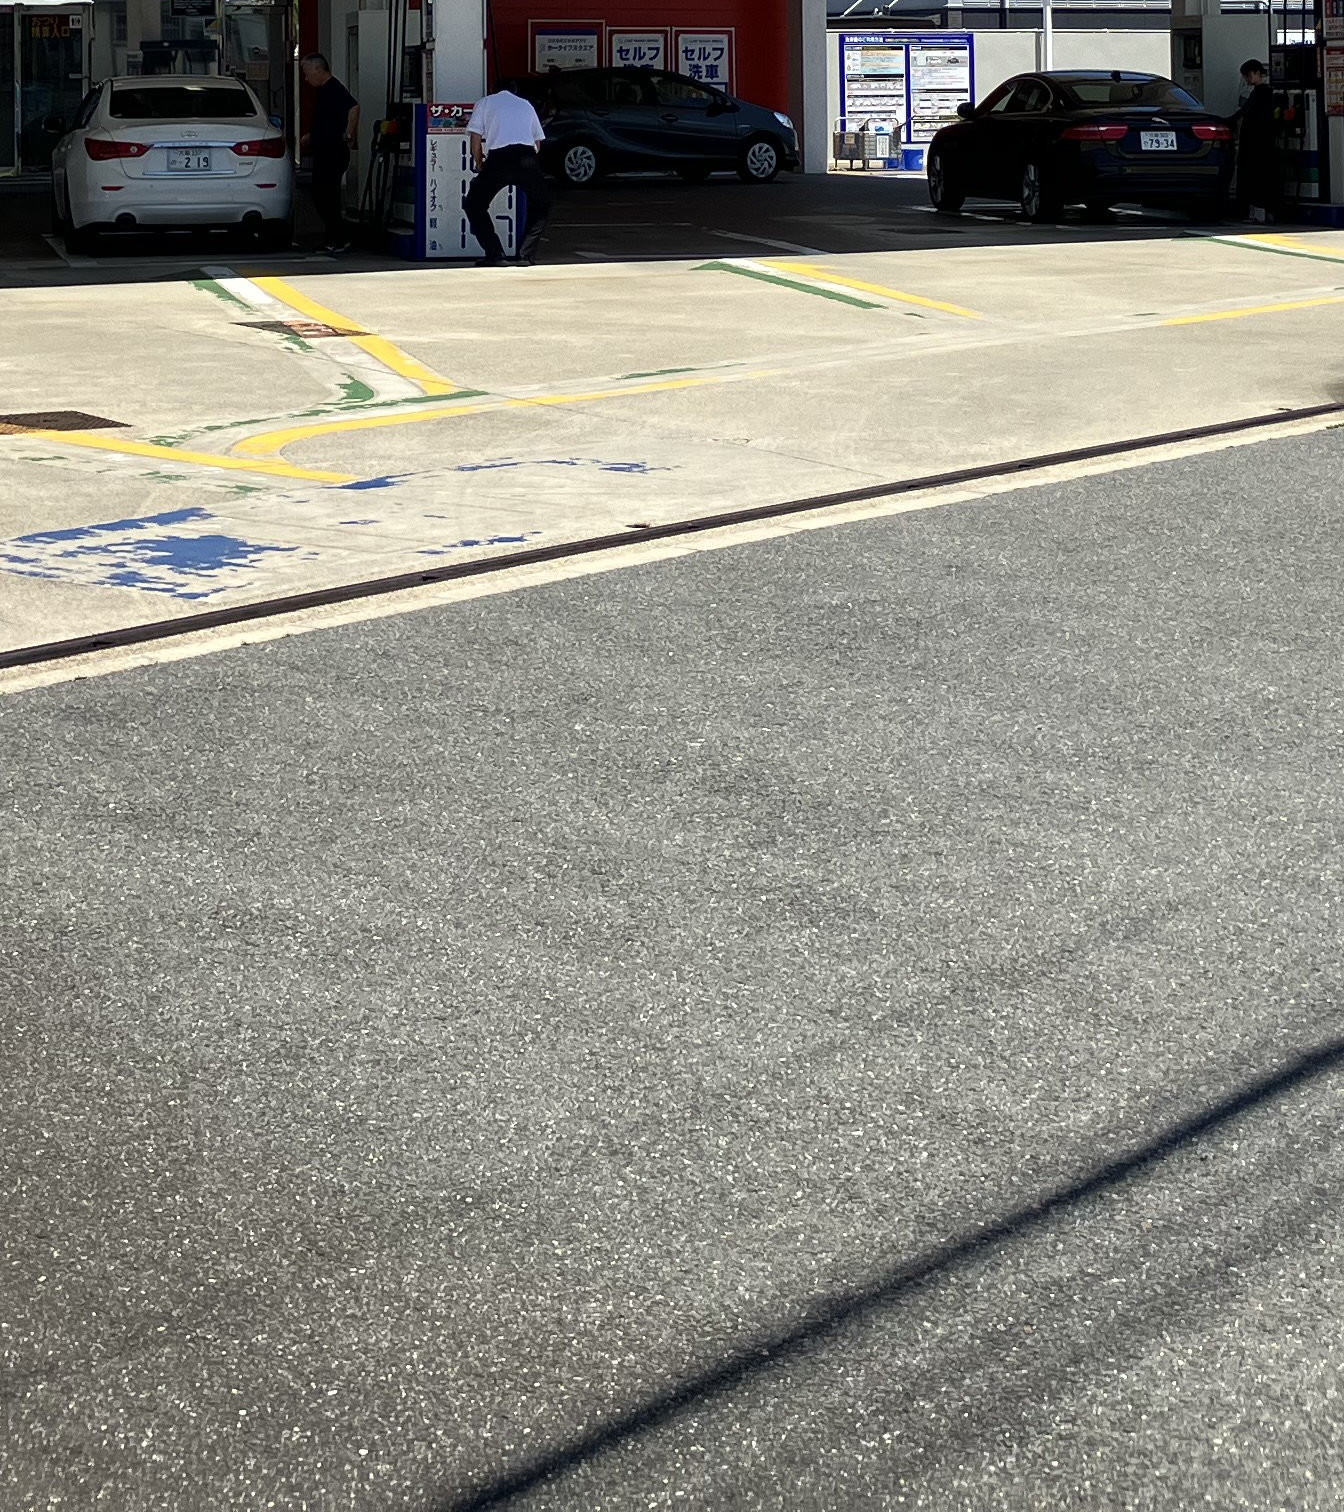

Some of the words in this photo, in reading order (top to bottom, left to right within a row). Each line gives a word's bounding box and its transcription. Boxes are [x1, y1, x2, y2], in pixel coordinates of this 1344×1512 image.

[616, 45, 661, 62] セルフ
[682, 45, 725, 62] セルフ
[688, 63, 720, 80] 洗車
[430, 105, 475, 118] ザ・カー
[430, 139, 438, 172] レギュラー
[429, 178, 438, 213] ハイオク
[461, 215, 513, 249] 17
